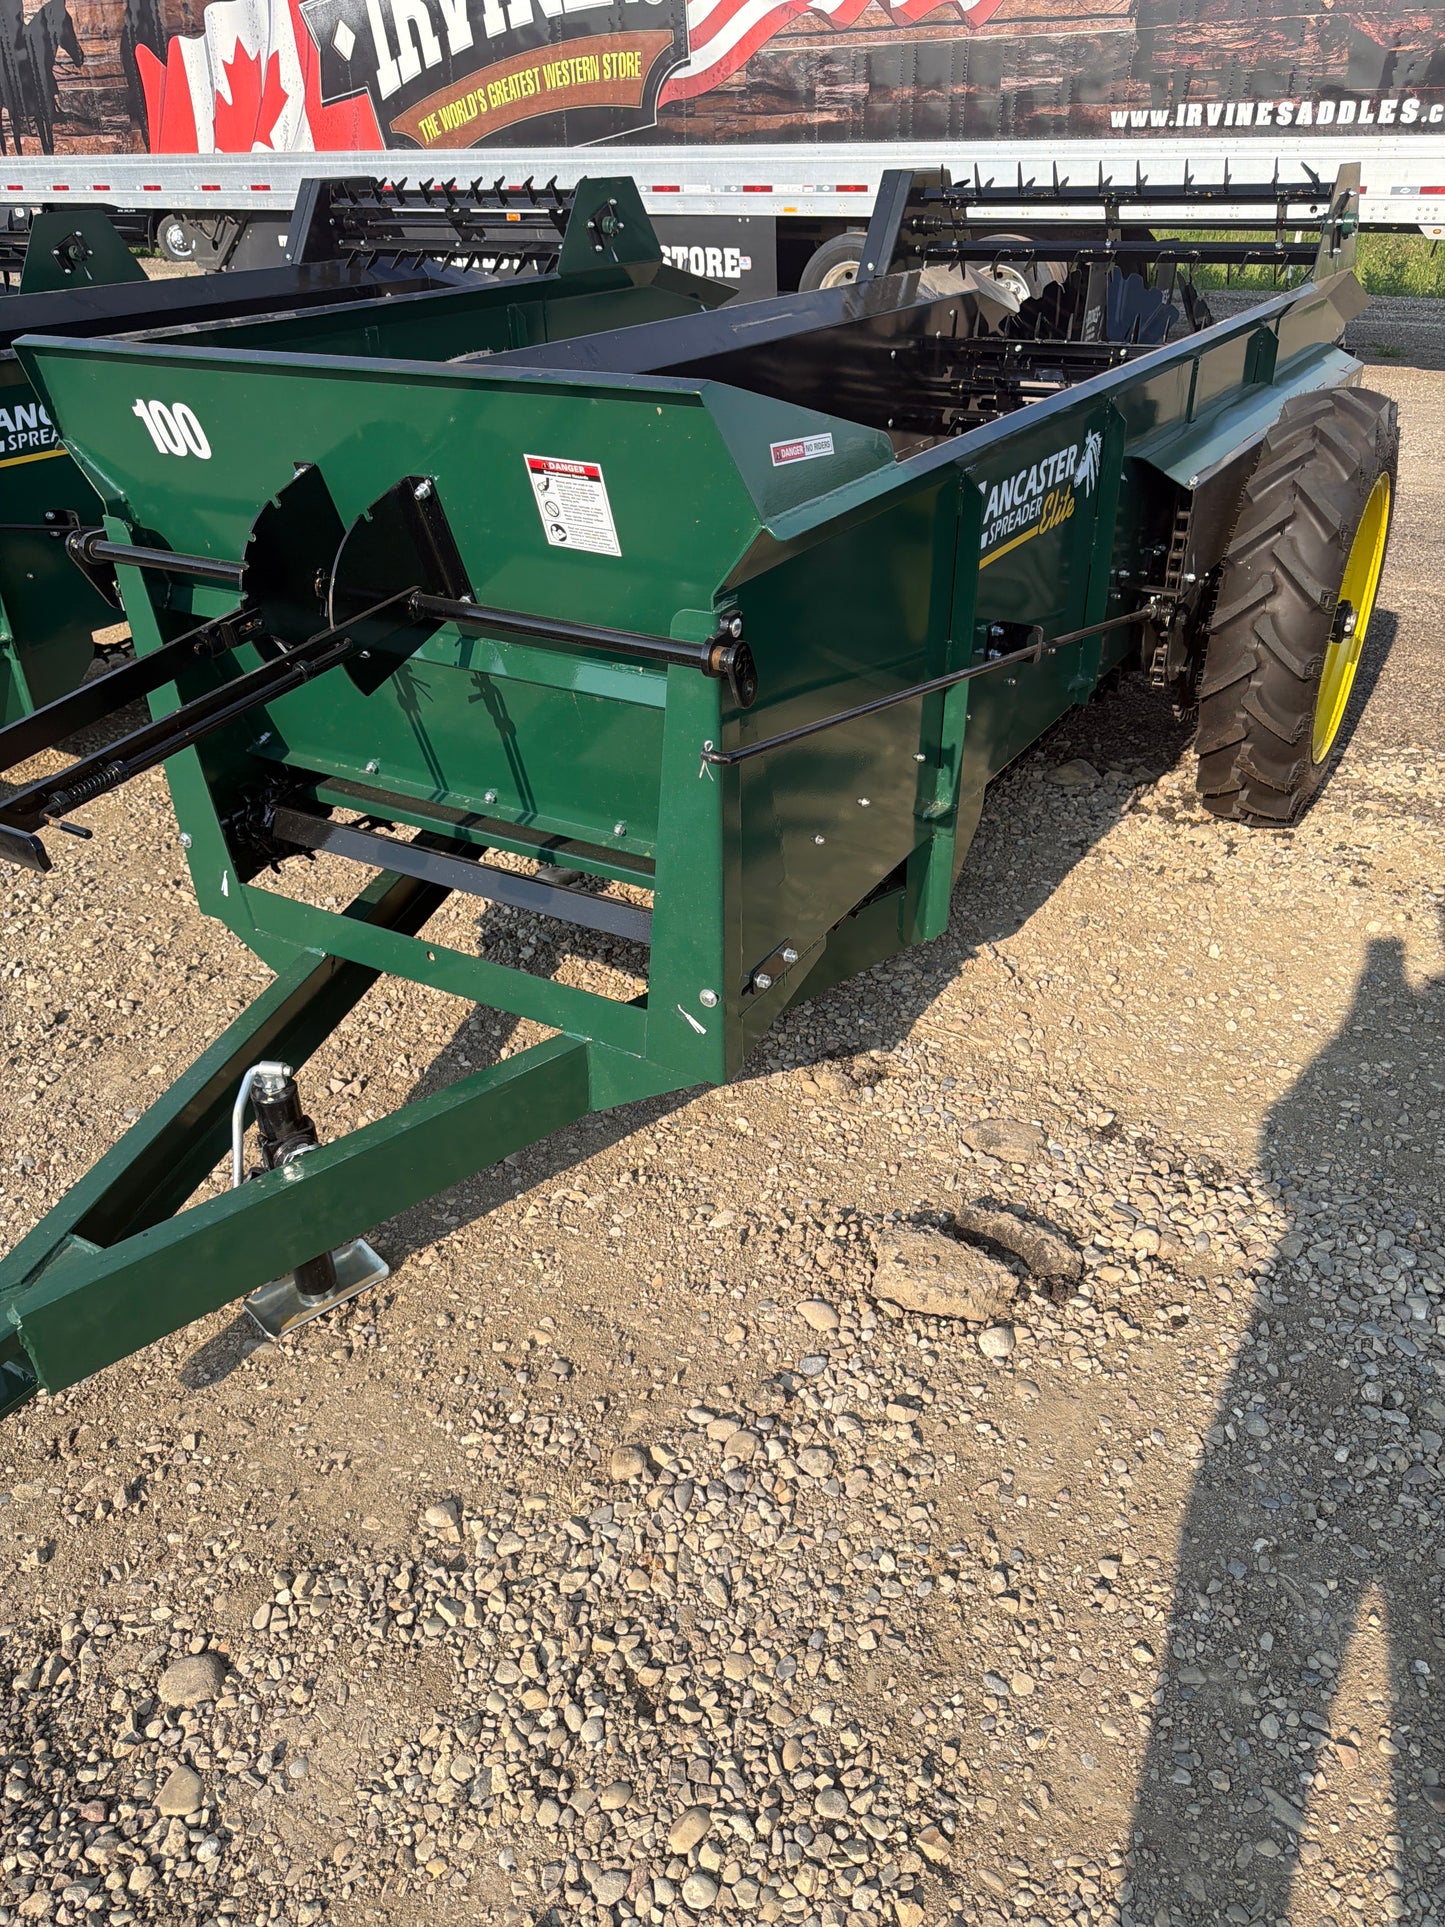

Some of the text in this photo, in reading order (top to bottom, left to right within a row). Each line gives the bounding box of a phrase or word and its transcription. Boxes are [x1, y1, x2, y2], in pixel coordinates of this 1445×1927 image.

[418, 52, 642, 143] THE WORLD'S GREATEST WESTERN STORE
[132, 399, 212, 460] 100
[781, 445, 804, 459] DANGER
[805, 443, 814, 452] NO
[547, 461, 586, 474] DANGER
[988, 496, 1043, 545] SPREADER
[1039, 484, 1075, 535] Elite
